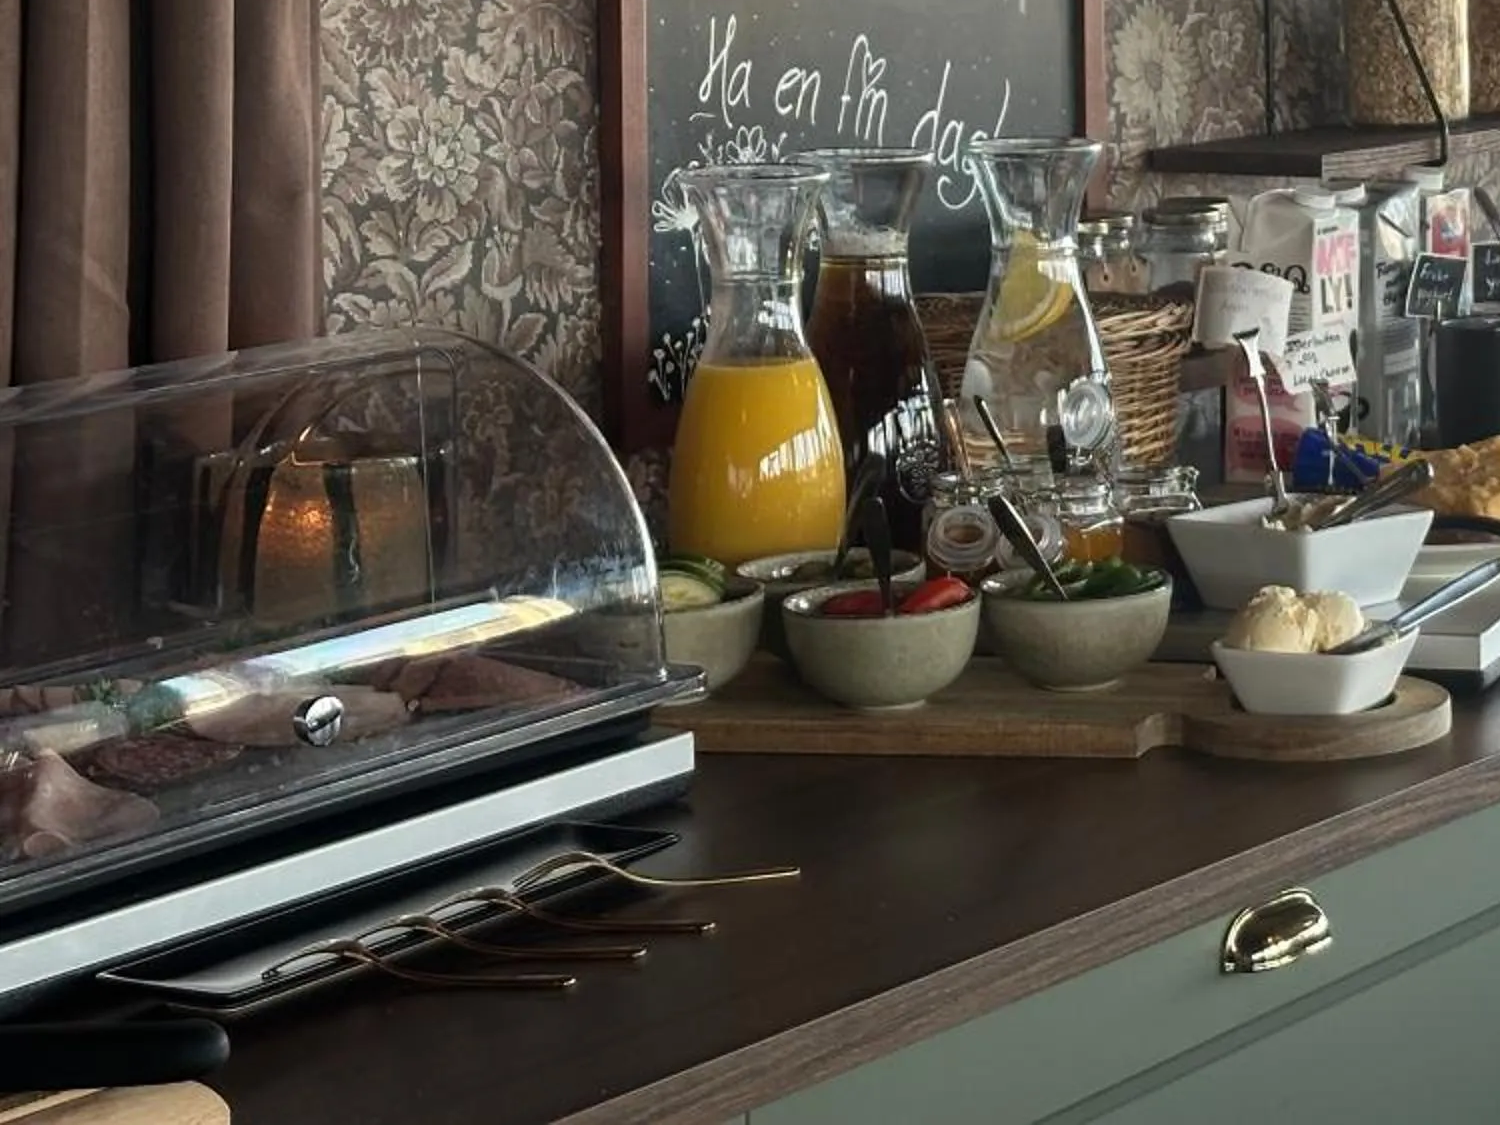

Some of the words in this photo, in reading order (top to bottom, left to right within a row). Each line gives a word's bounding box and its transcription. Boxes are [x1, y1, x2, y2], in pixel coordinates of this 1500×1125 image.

[698, 13, 752, 129] Ha
[774, 67, 822, 125] en
[837, 34, 888, 148] fin
